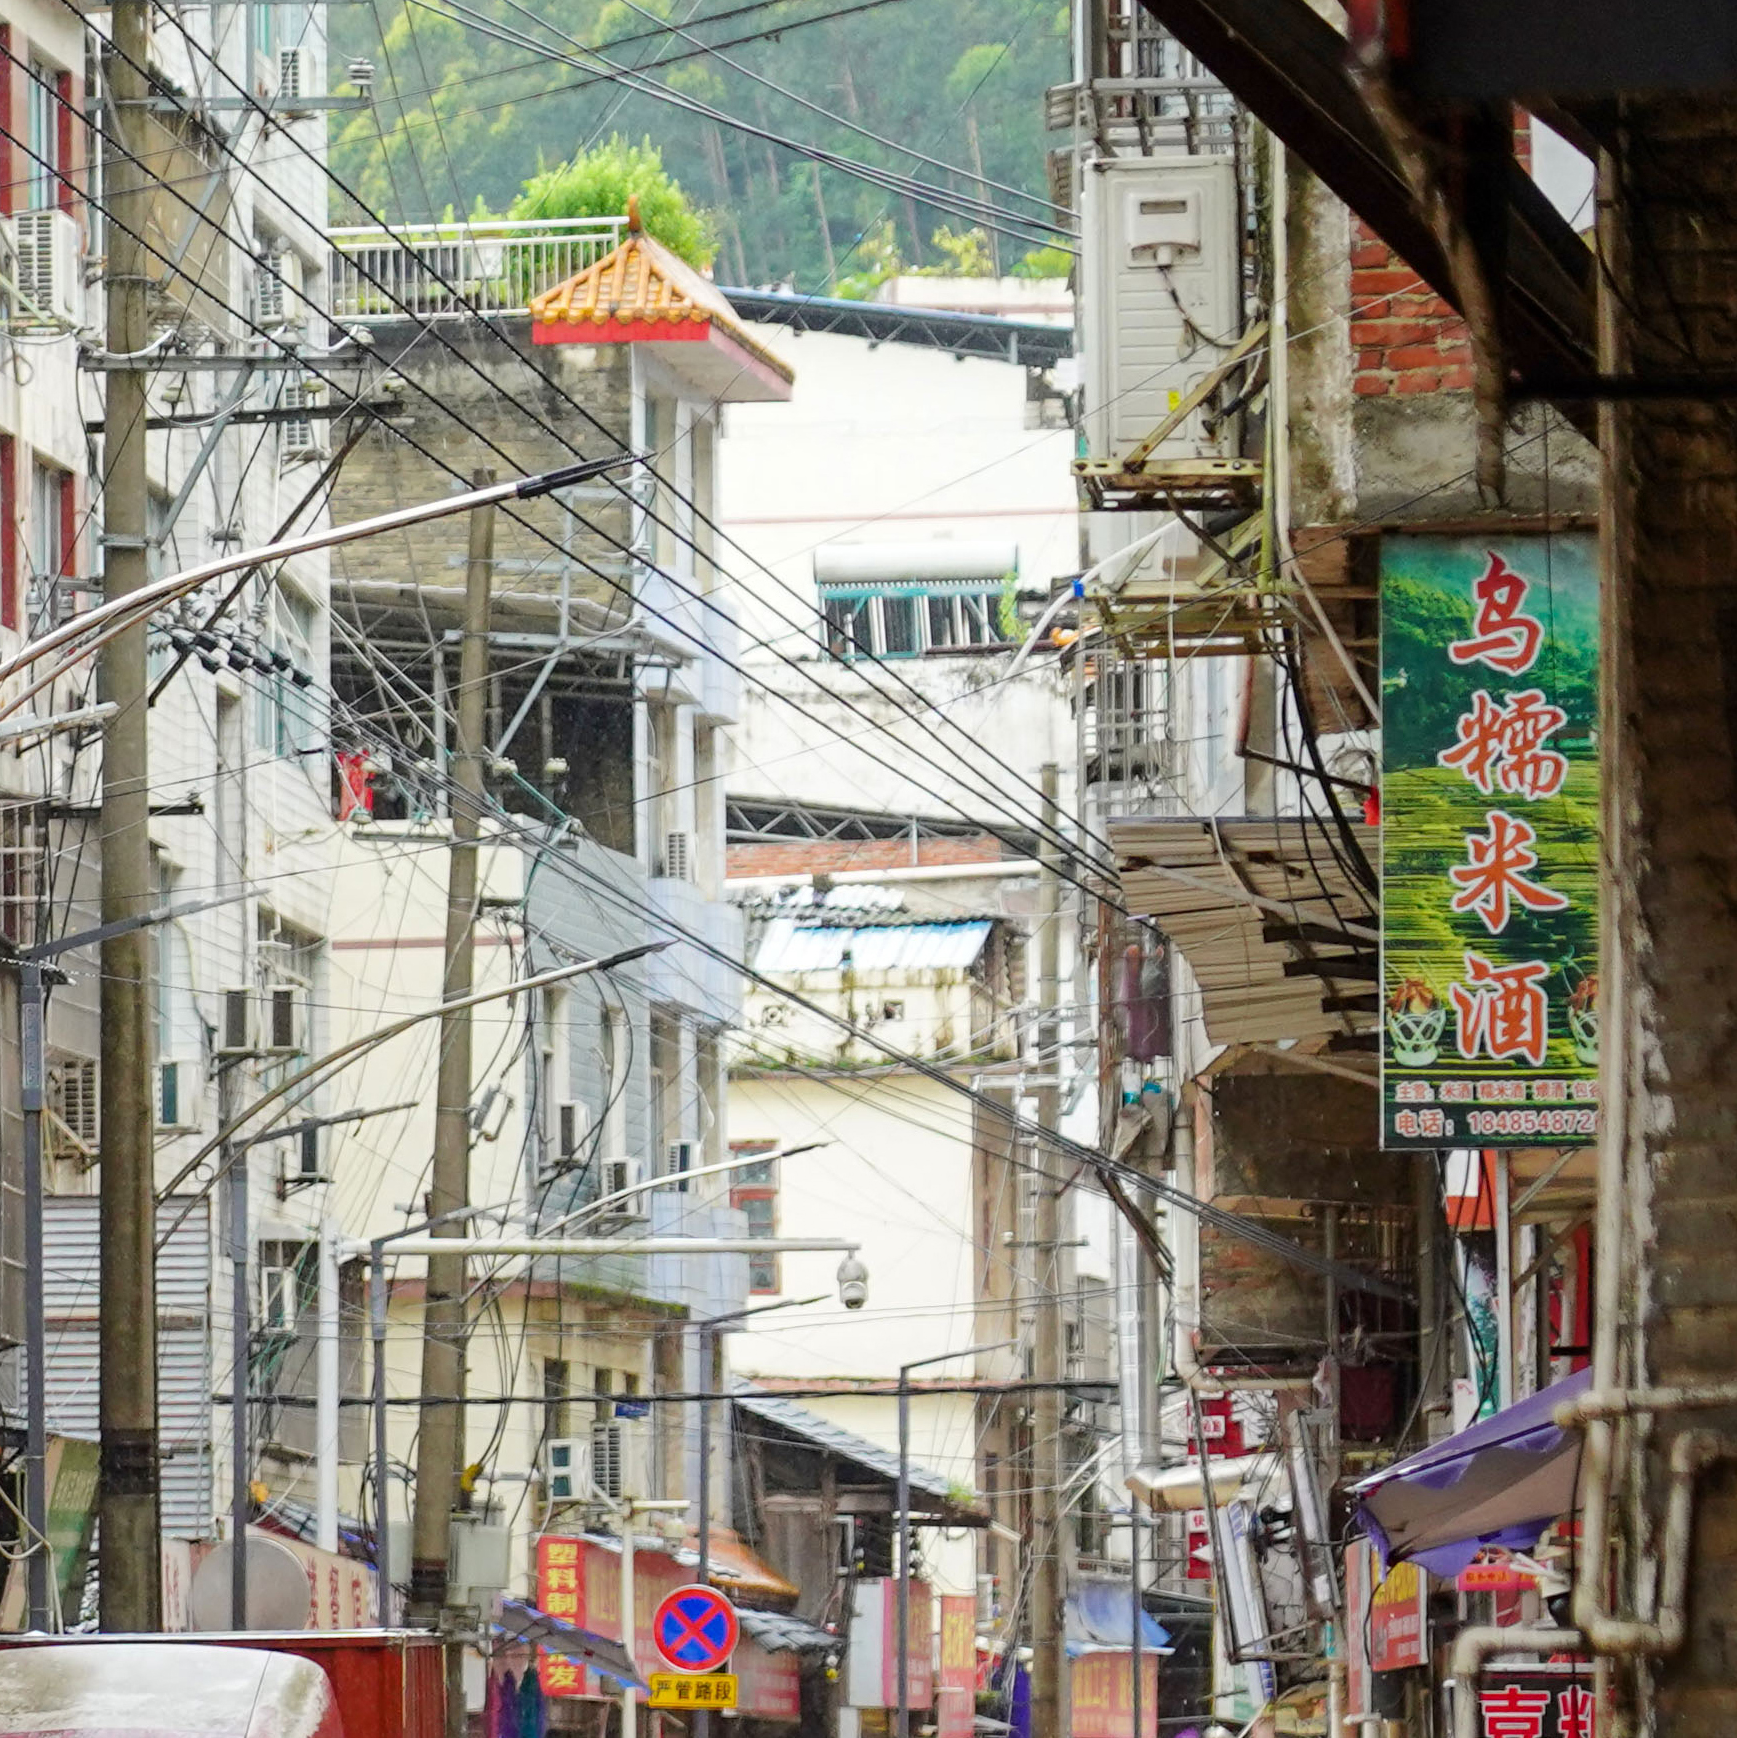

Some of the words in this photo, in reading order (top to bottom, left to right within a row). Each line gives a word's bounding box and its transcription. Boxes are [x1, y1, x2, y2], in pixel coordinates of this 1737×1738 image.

[1437, 547, 1571, 1069] 乌糯米酒
[1395, 1109, 1455, 1137] 电话：
[1467, 1110, 1598, 1135] 184854872
[546, 1542, 579, 1686] 塑料制发
[652, 1680, 732, 1700] 严管路段
